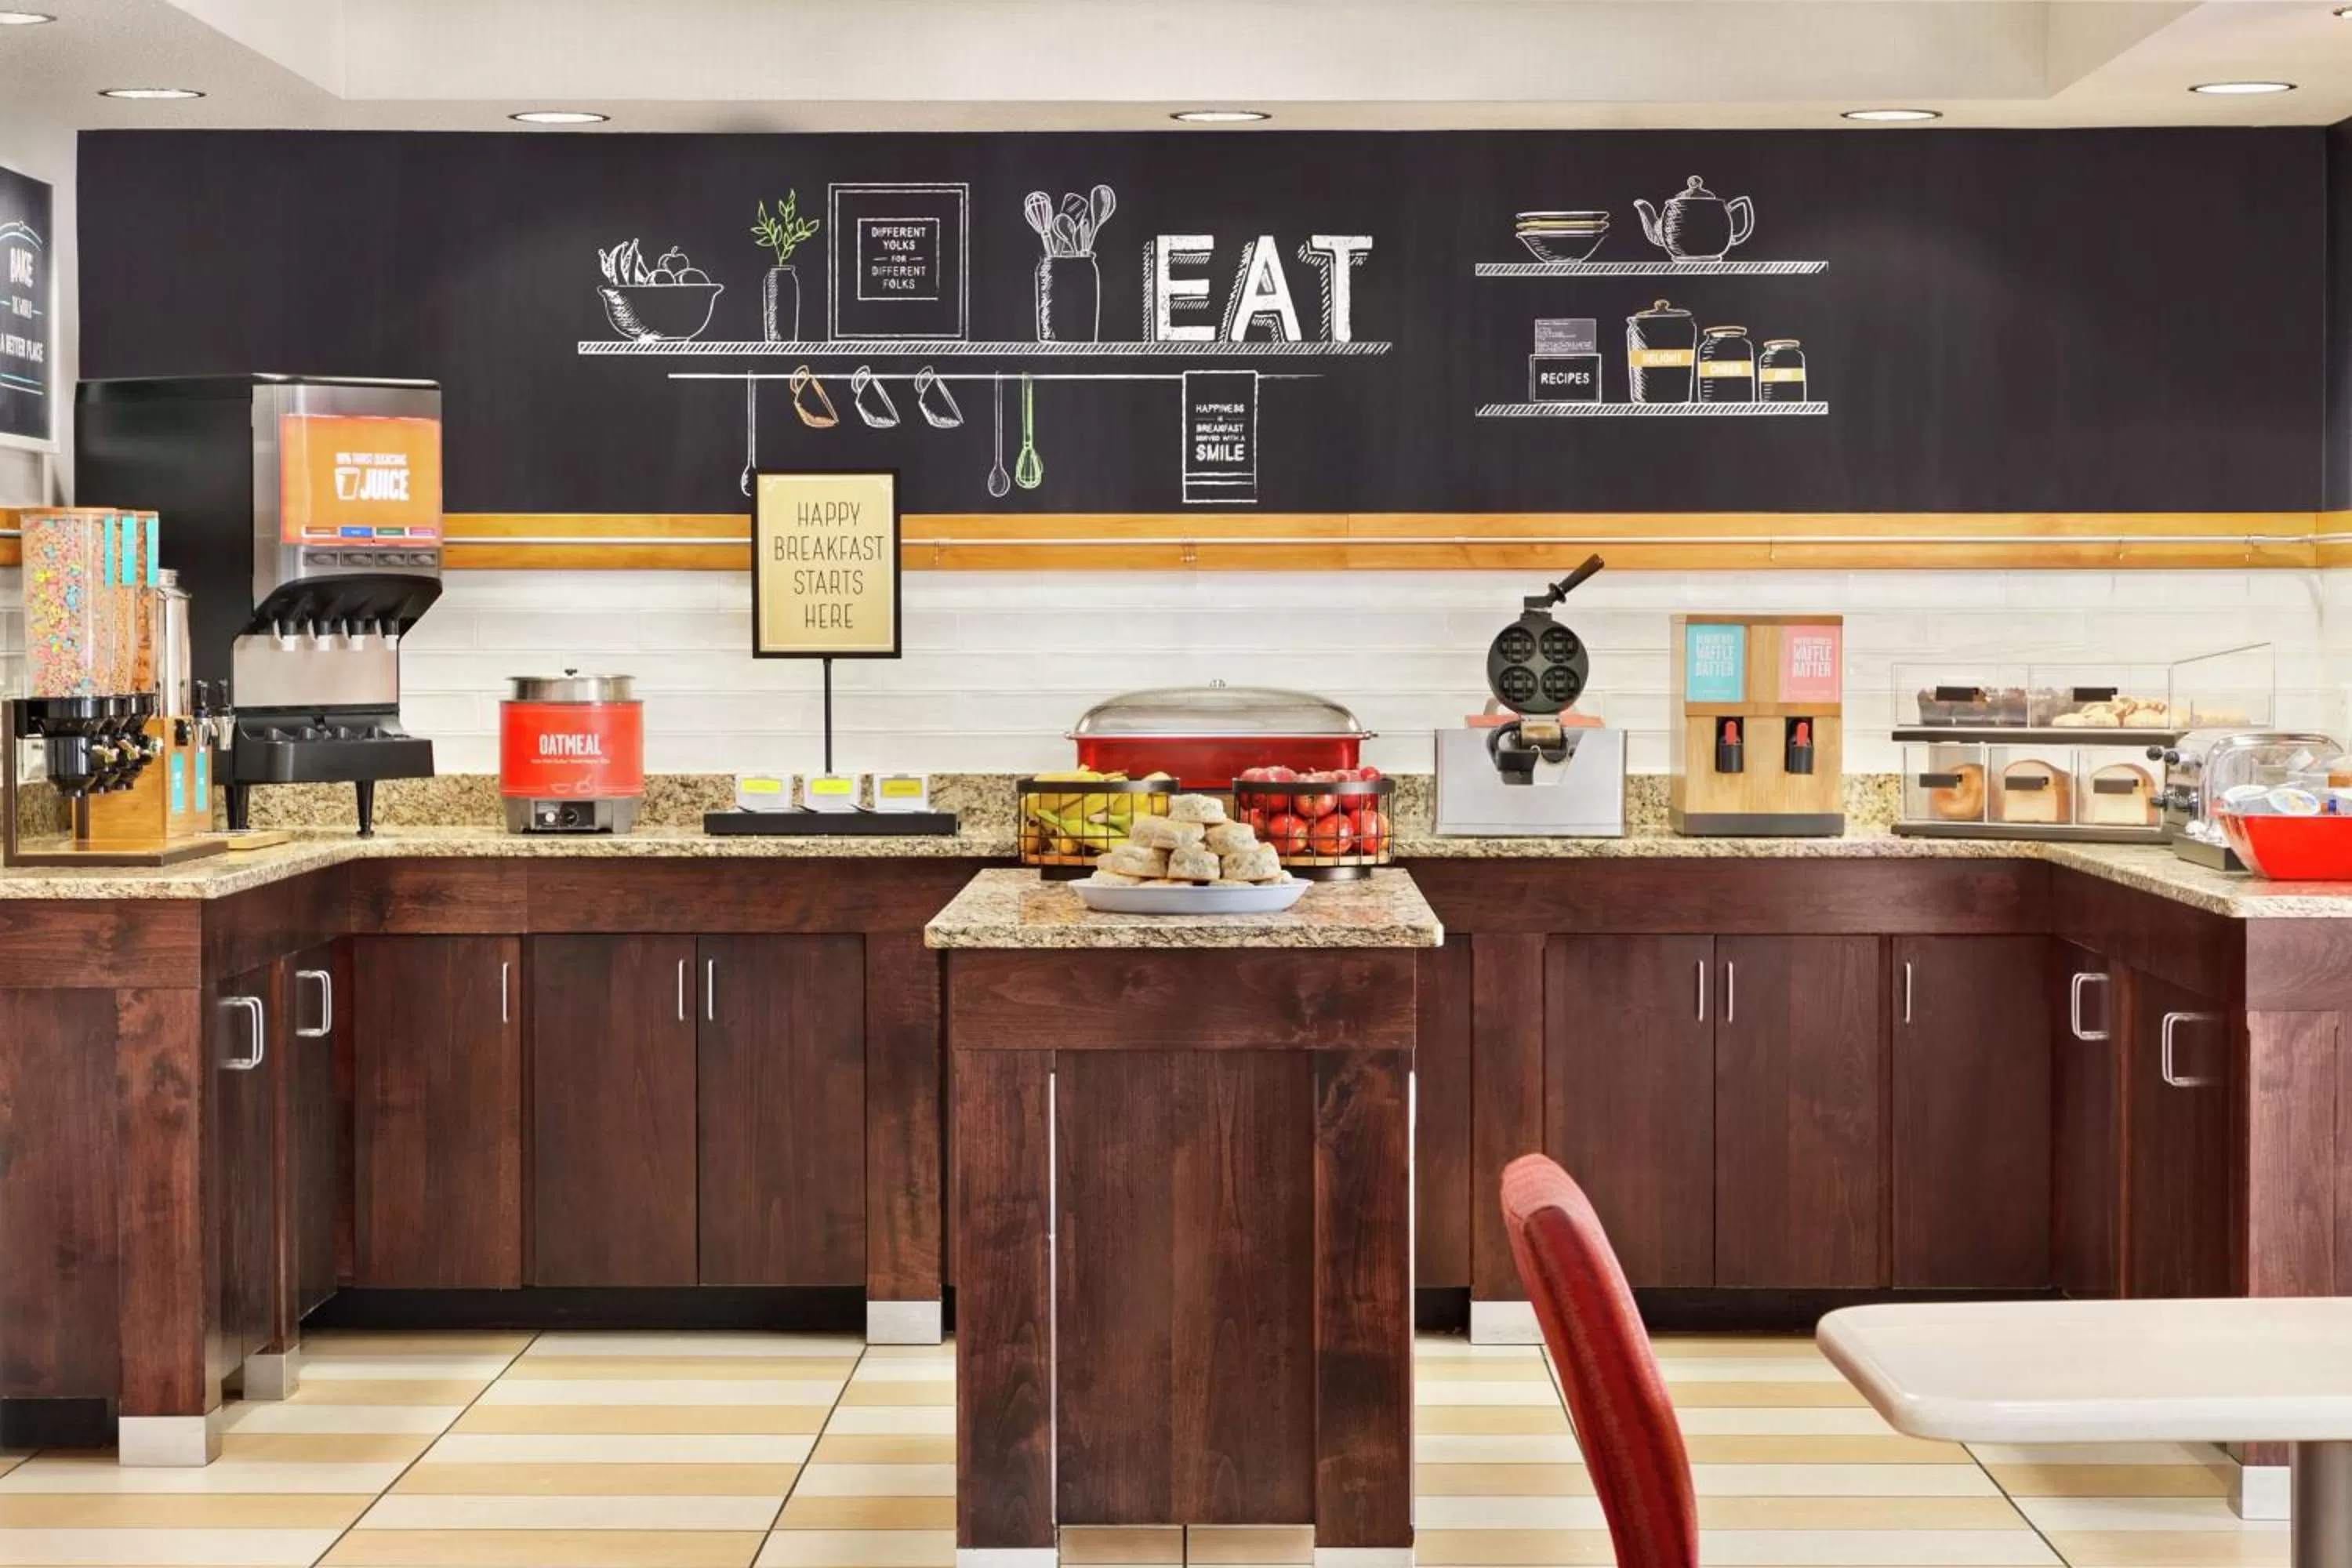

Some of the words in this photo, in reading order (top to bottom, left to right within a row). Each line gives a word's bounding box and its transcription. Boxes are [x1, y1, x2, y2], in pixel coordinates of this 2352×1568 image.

[871, 227, 926, 238] DIFFERENT
[882, 239, 916, 250] YOLKS
[871, 266, 926, 276] DIFFERENT
[882, 278, 916, 289] FOLKS
[1144, 234, 1373, 343] EAT
[1541, 372, 1591, 385] RECIPES
[1196, 404, 1245, 414] HAPPINESS
[1196, 423, 1243, 434] BREAKFAST
[1196, 444, 1245, 462] SMILE
[360, 468, 410, 501] JUICE
[797, 501, 861, 527] HAPPY
[774, 535, 885, 561] BREAKFAST
[794, 570, 864, 595] STARTS
[805, 603, 854, 629] HERE
[539, 734, 602, 755] OATMEAL
